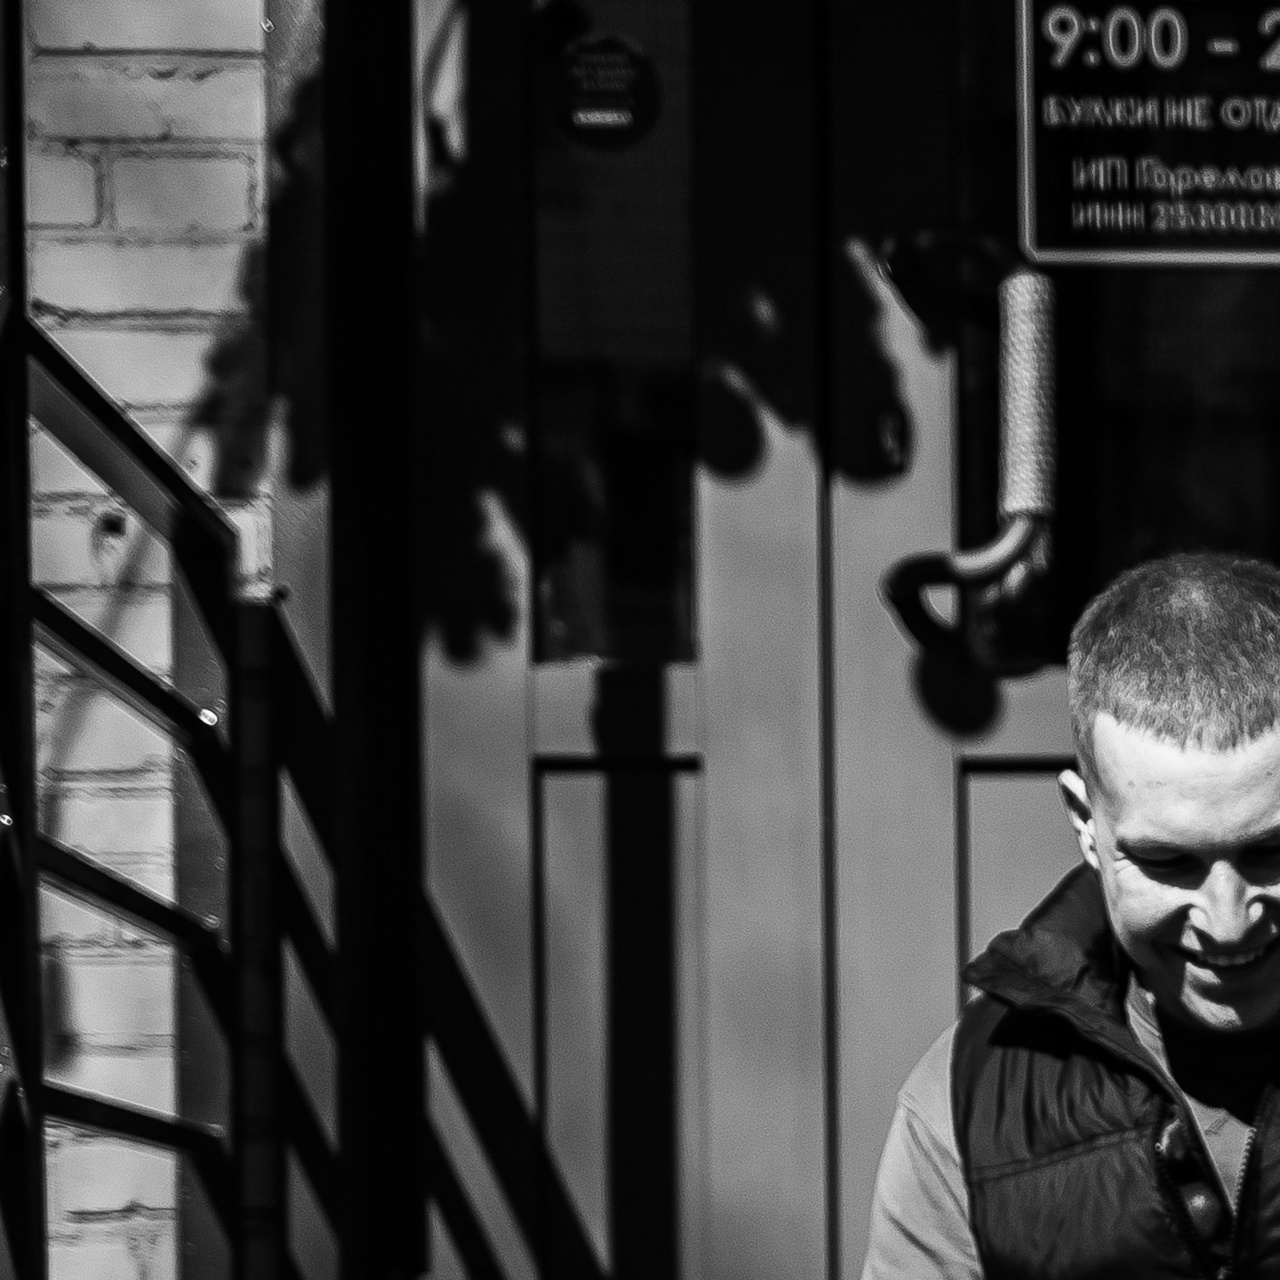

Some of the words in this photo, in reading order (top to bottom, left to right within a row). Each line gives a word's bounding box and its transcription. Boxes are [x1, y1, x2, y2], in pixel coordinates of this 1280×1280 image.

[1043, 8, 1188, 69] 9:00
[1042, 97, 1160, 128] БУЛКИ
[1164, 97, 1211, 128] НЕ
[1072, 157, 1128, 190] ИП
[1072, 202, 1145, 230] ИНН
